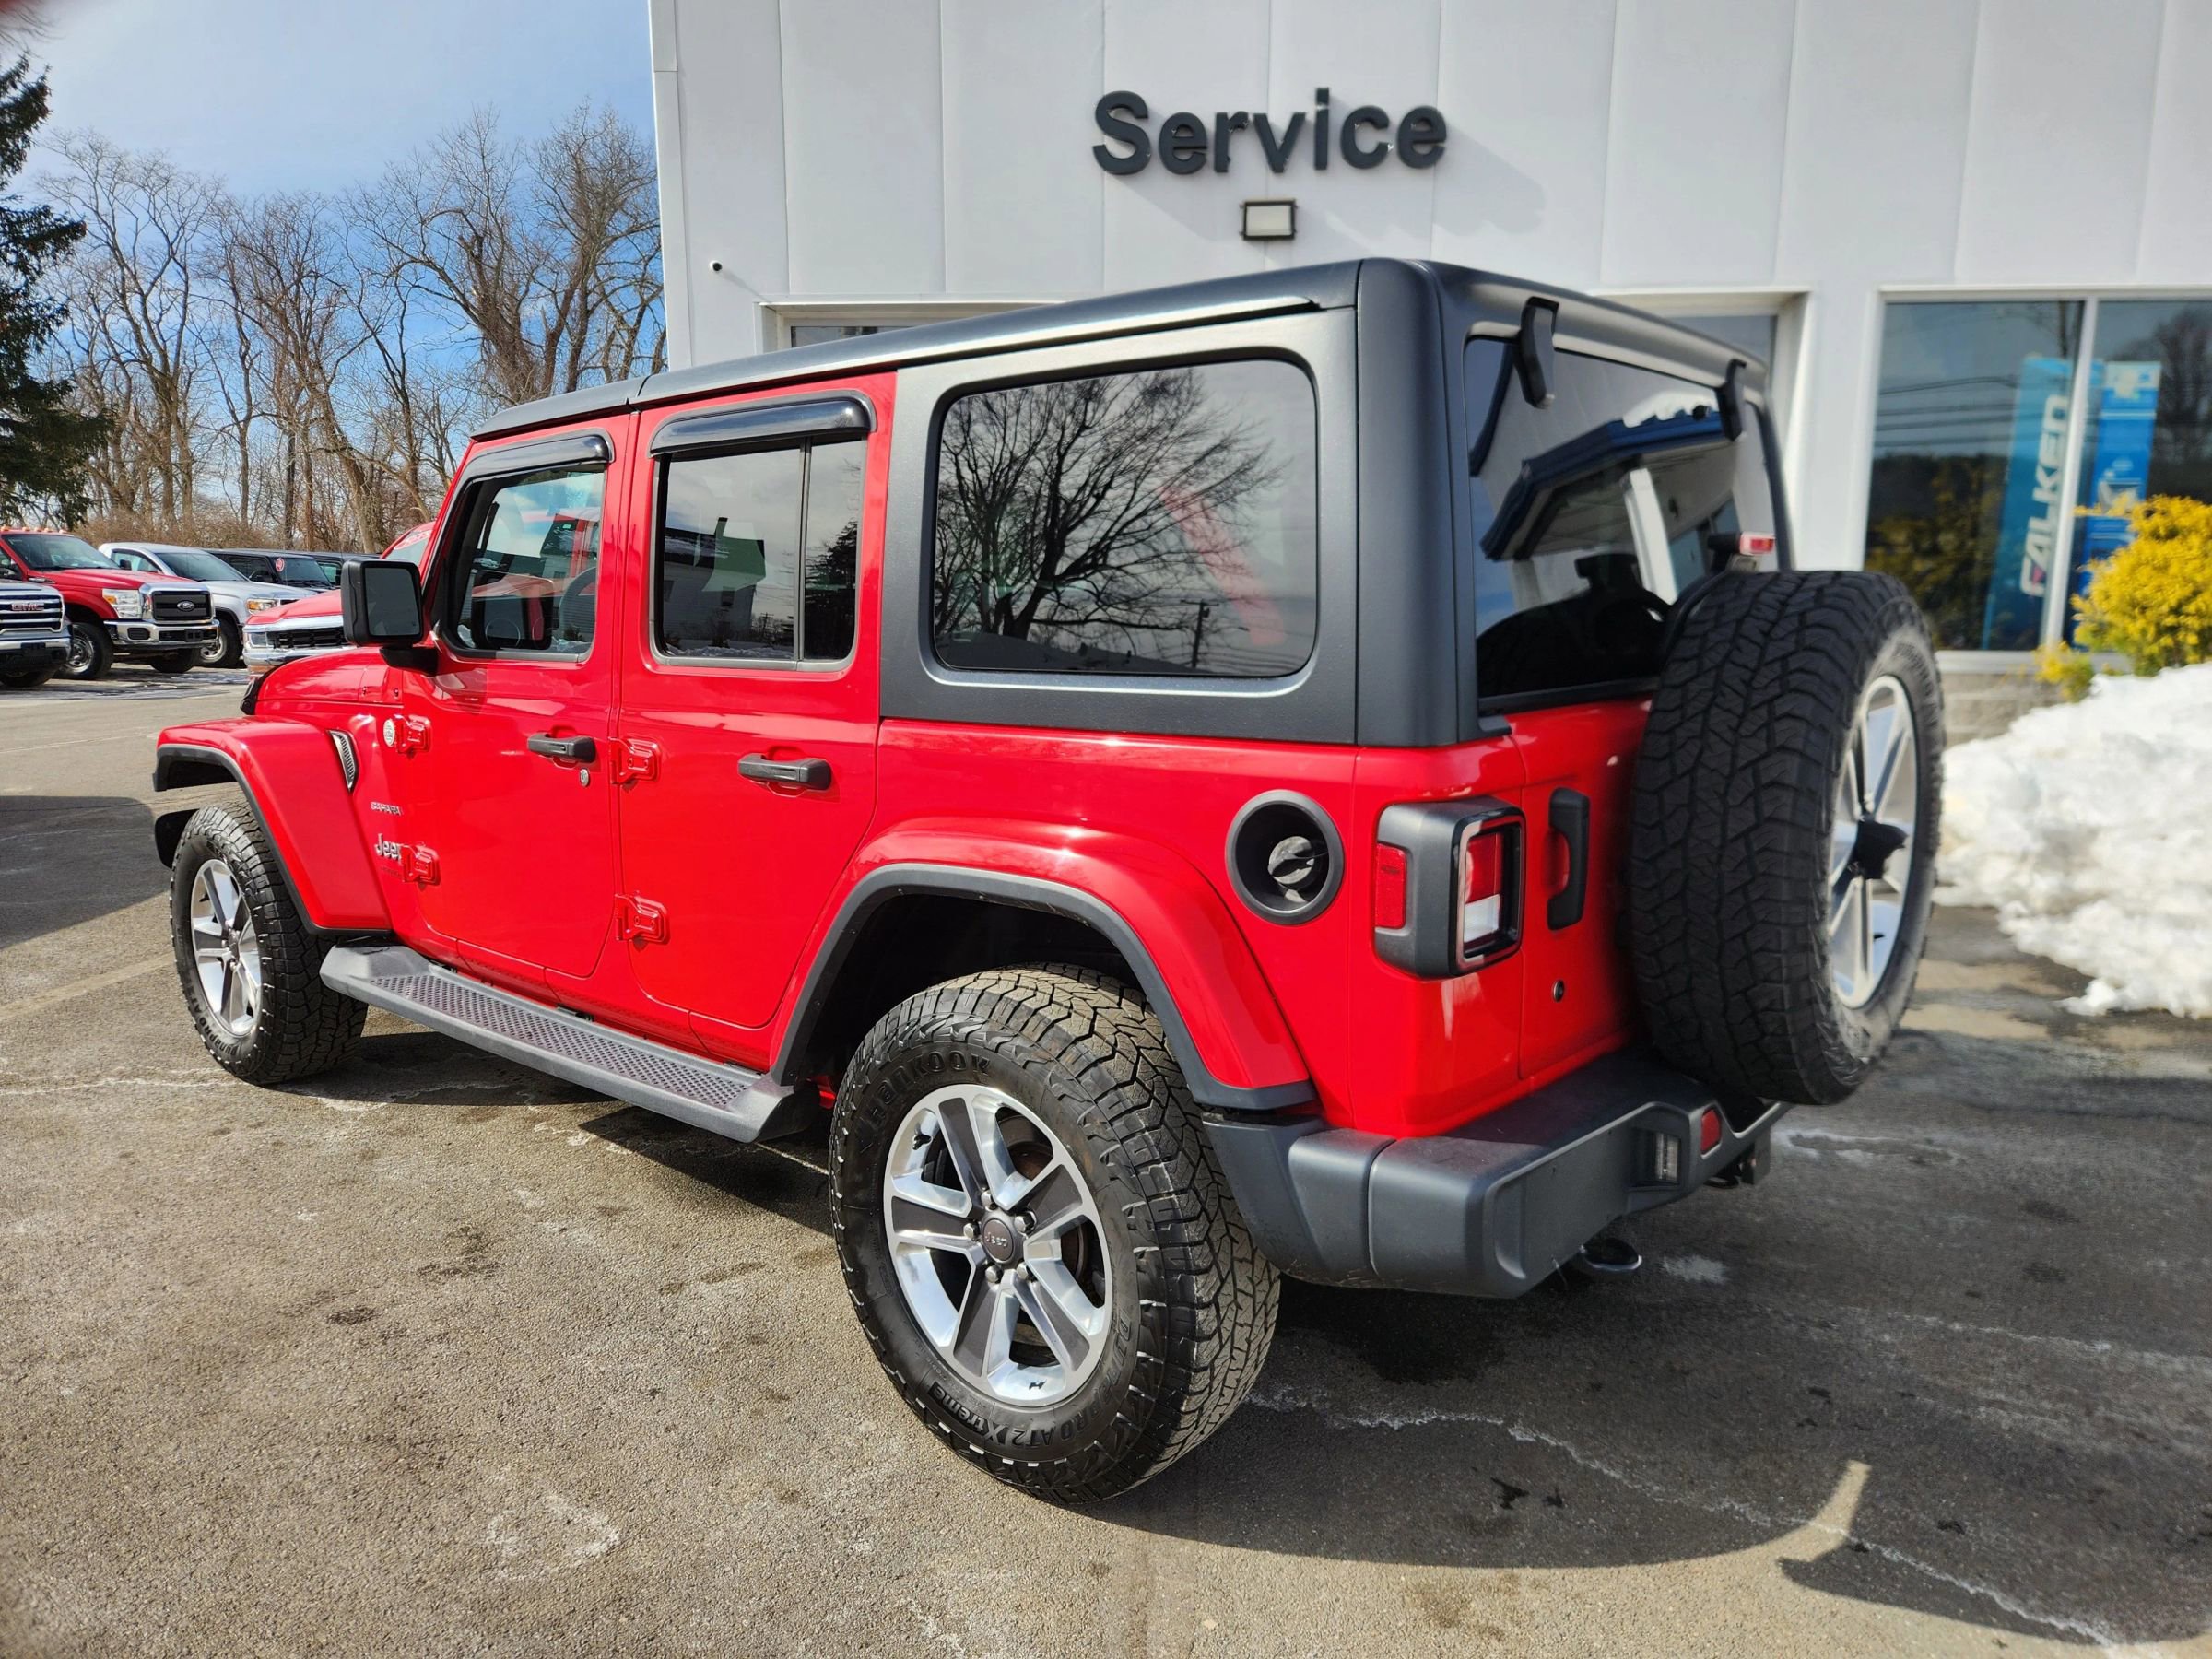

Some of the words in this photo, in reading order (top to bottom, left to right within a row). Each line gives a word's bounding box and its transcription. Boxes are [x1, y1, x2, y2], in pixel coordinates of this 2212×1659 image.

[1093, 87, 1448, 175] Service
[11, 602, 45, 612] GMC
[984, 1231, 1007, 1248] Jeep
